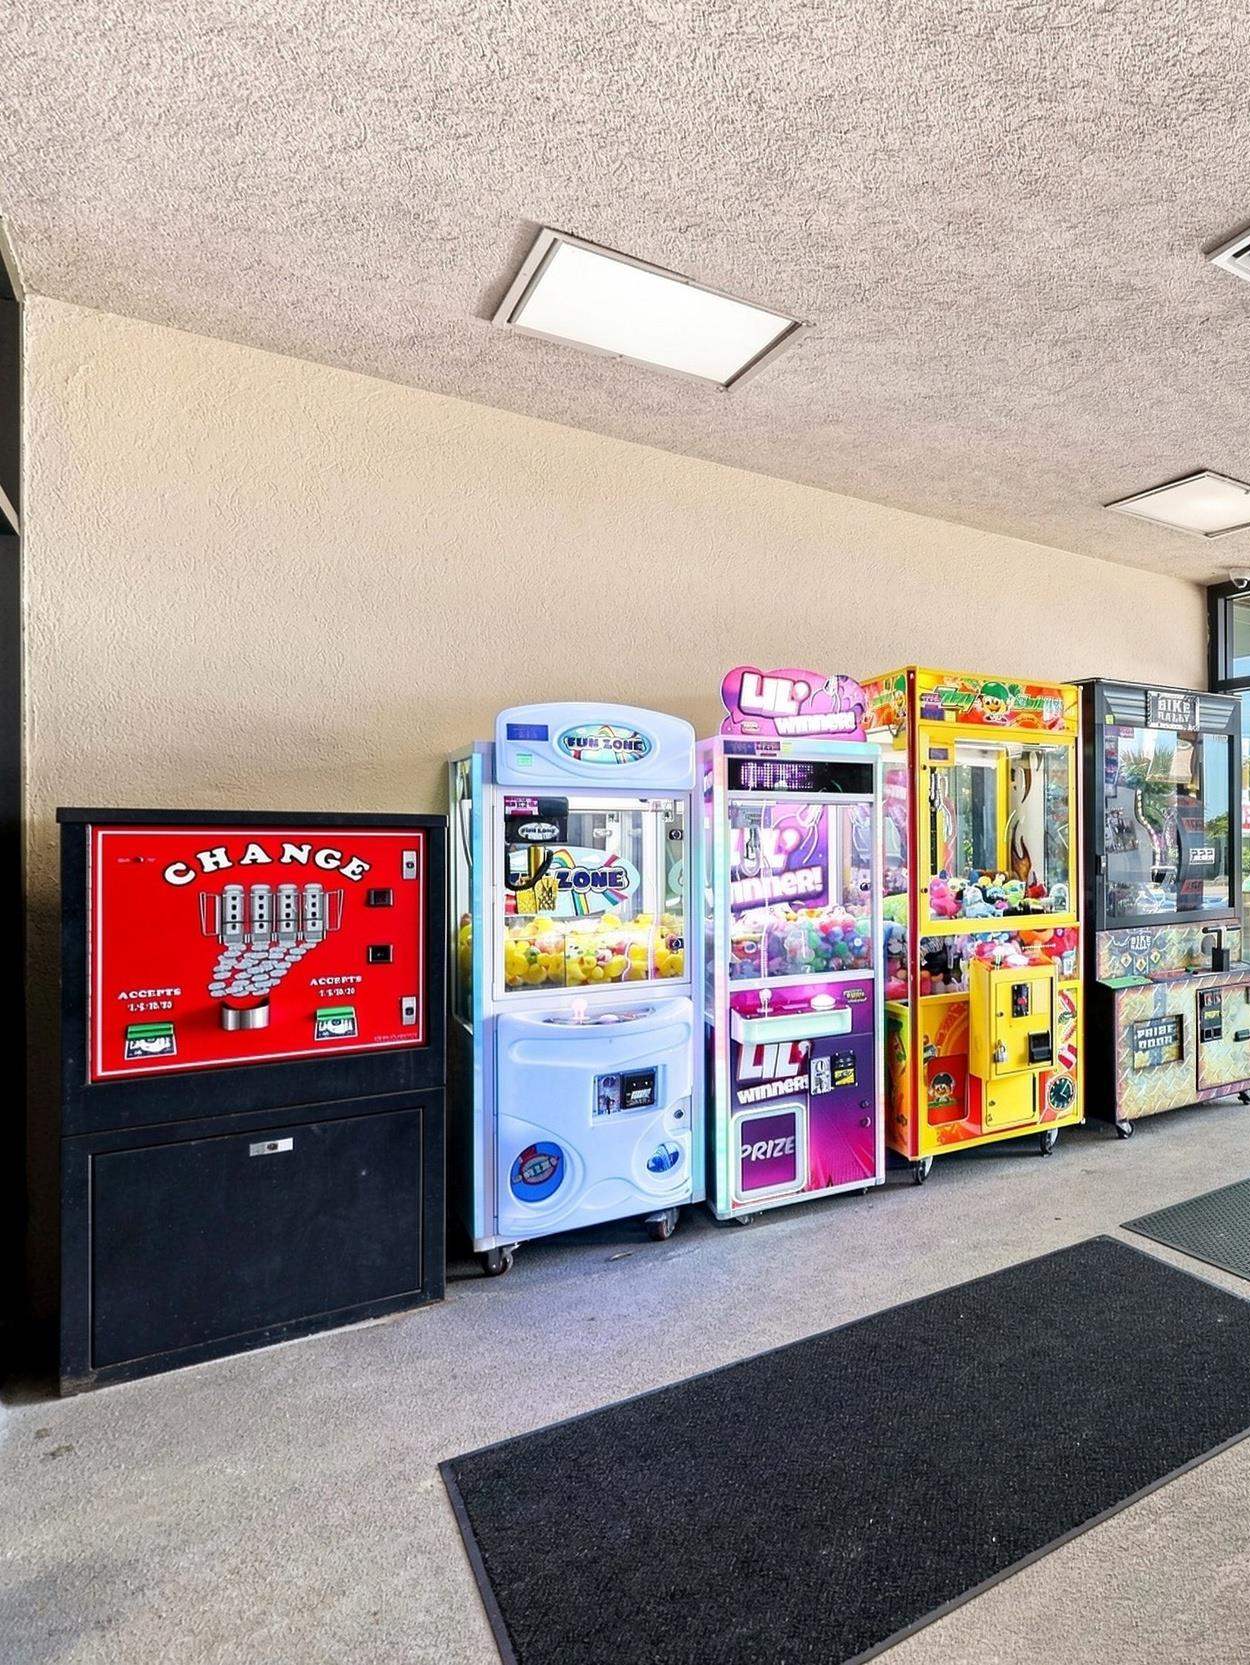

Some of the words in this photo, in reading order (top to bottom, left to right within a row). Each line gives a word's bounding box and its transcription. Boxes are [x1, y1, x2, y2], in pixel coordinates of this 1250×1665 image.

[1158, 699, 1190, 713] BIKE
[1158, 711, 1190, 723] RALLY
[567, 736, 599, 748] FUN
[602, 739, 643, 752] ZONE
[164, 843, 370, 885] CHANGE
[556, 870, 625, 889] ZONE
[307, 976, 362, 986] ACCEPTS
[118, 988, 181, 1000] ACCEPTS
[741, 1136, 794, 1161] PRIZE
